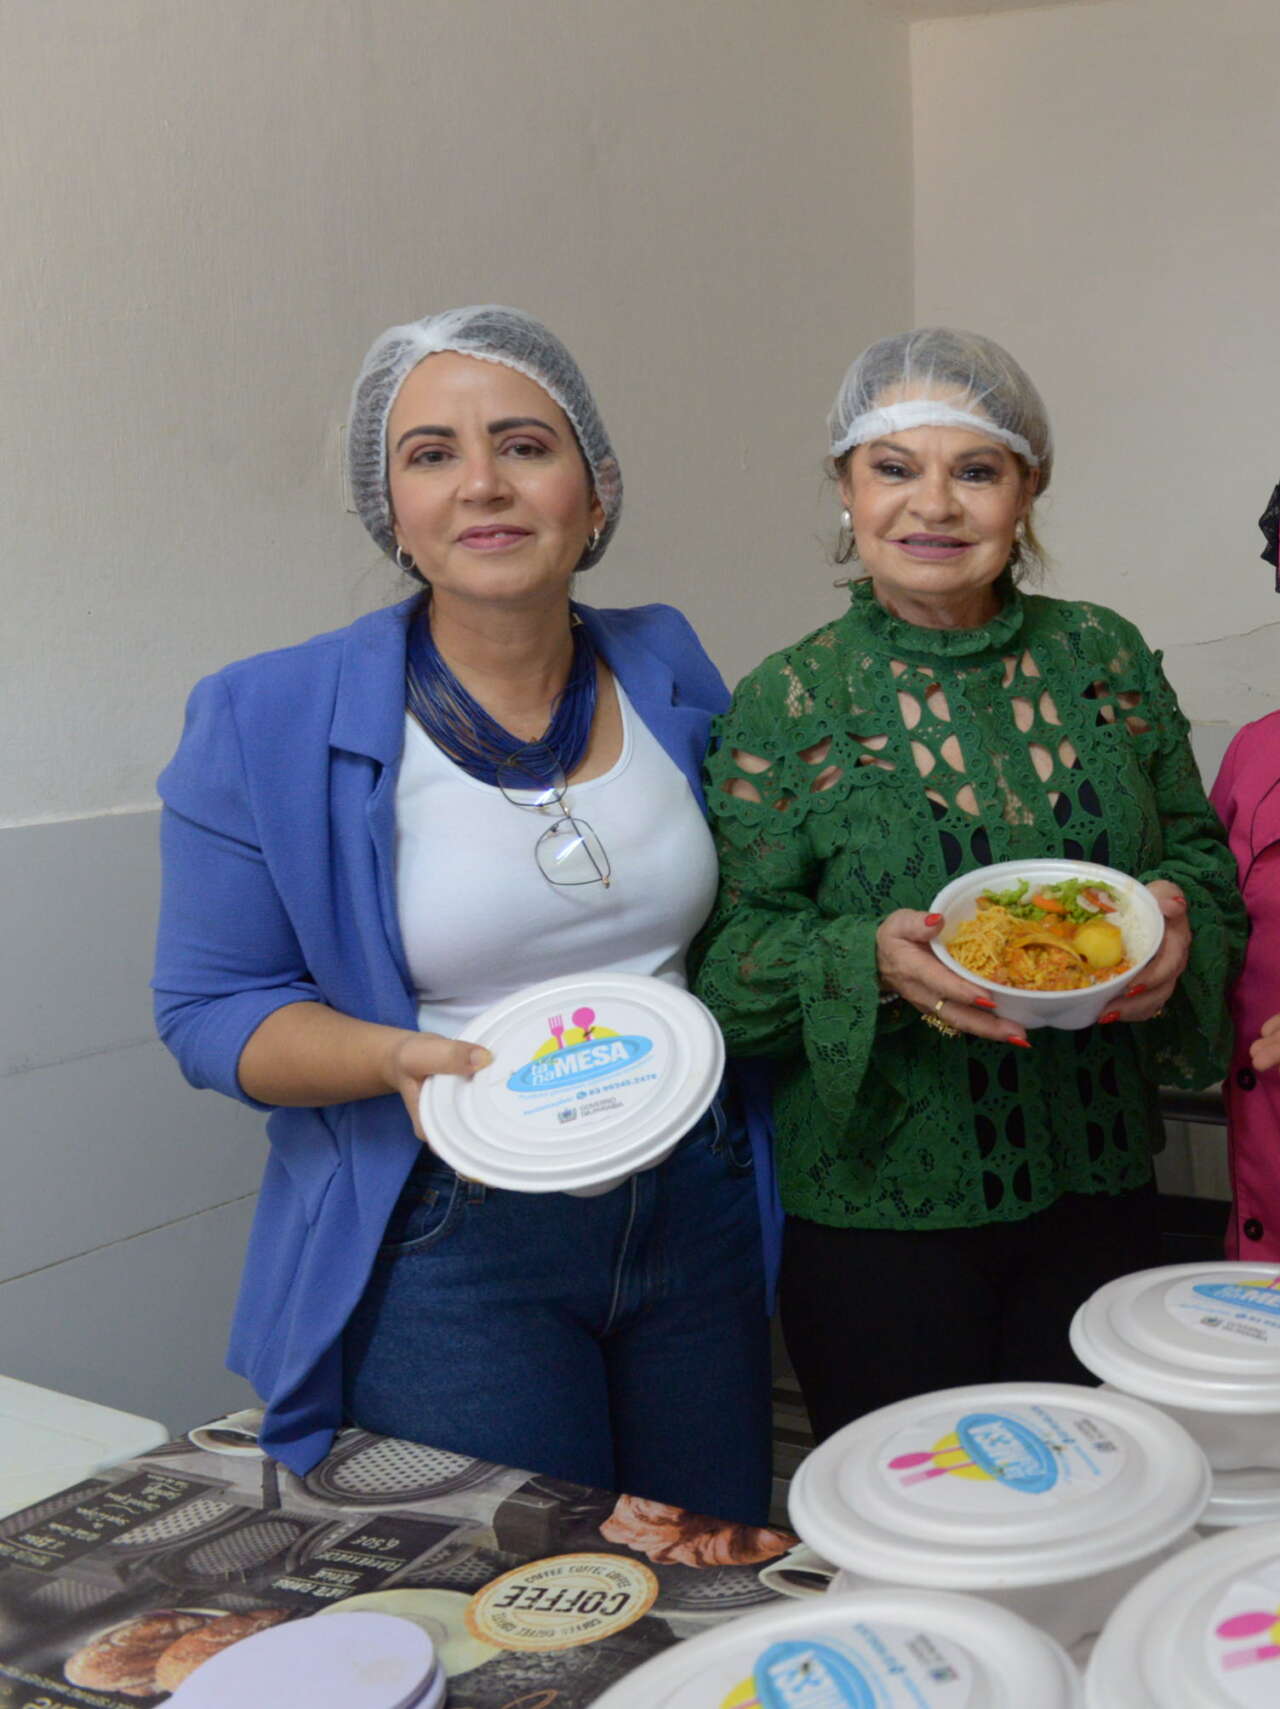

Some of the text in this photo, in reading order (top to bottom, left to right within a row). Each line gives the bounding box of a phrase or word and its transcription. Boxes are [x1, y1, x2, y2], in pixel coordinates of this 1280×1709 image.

[553, 1040, 630, 1078] MESA
[967, 1420, 1036, 1467] MESA
[493, 1585, 631, 1616] COFFEE
